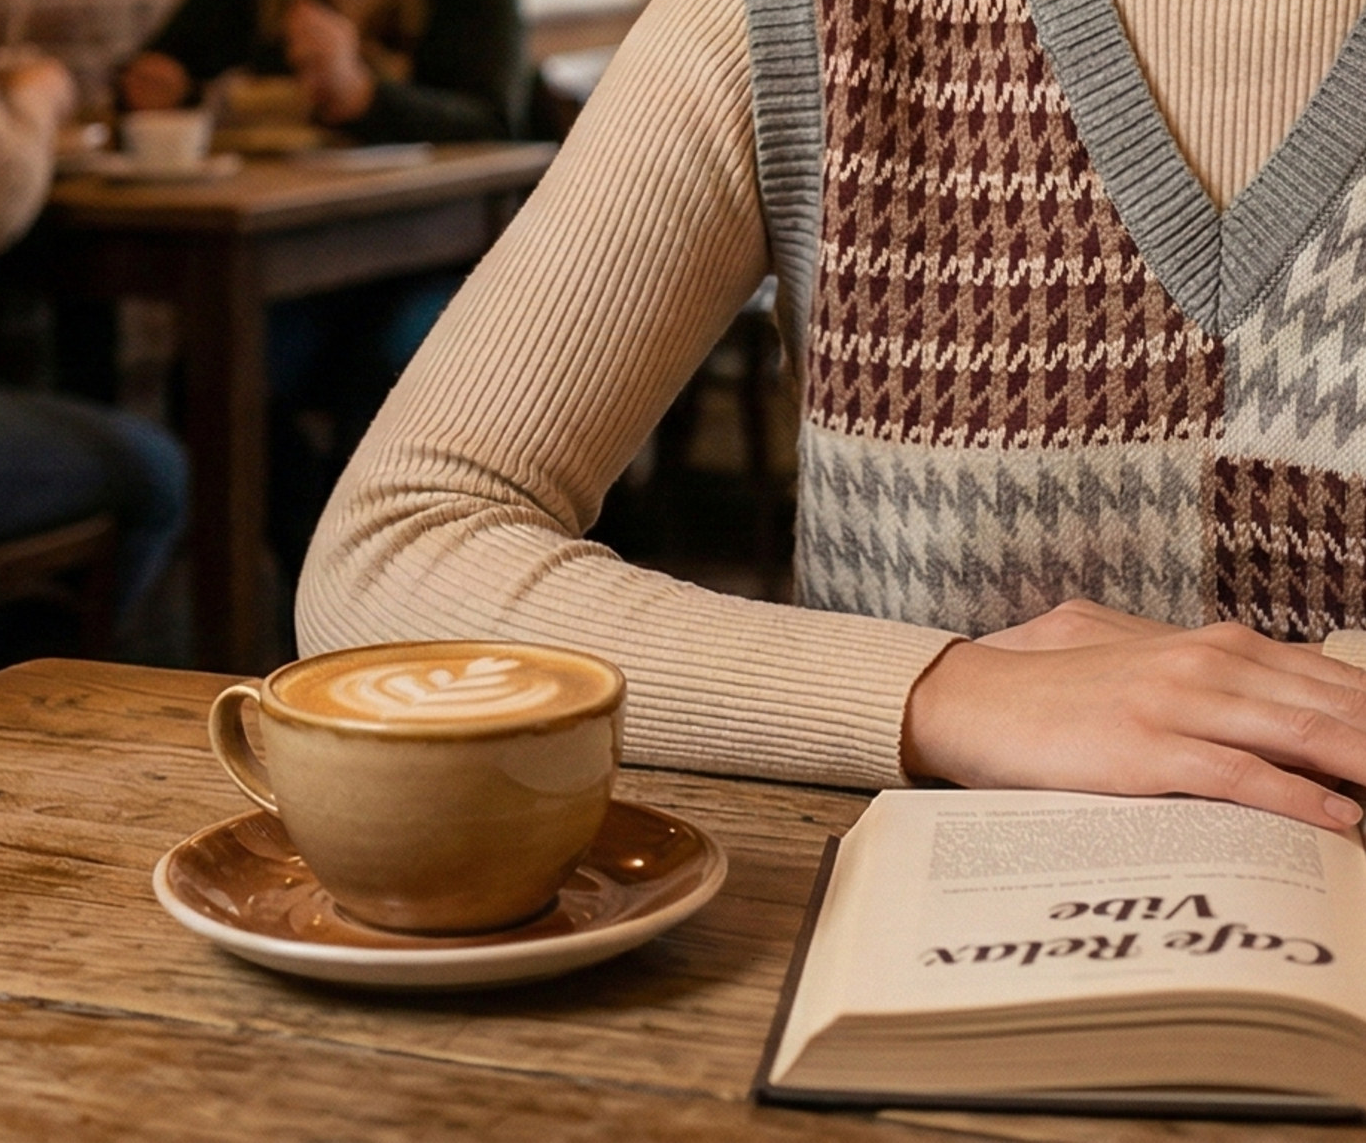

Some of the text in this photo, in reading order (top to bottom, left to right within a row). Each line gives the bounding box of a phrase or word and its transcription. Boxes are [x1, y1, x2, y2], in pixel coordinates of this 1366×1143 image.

[1048, 894, 1217, 922] Vibe
[923, 922, 1335, 966] Cafe Relax
